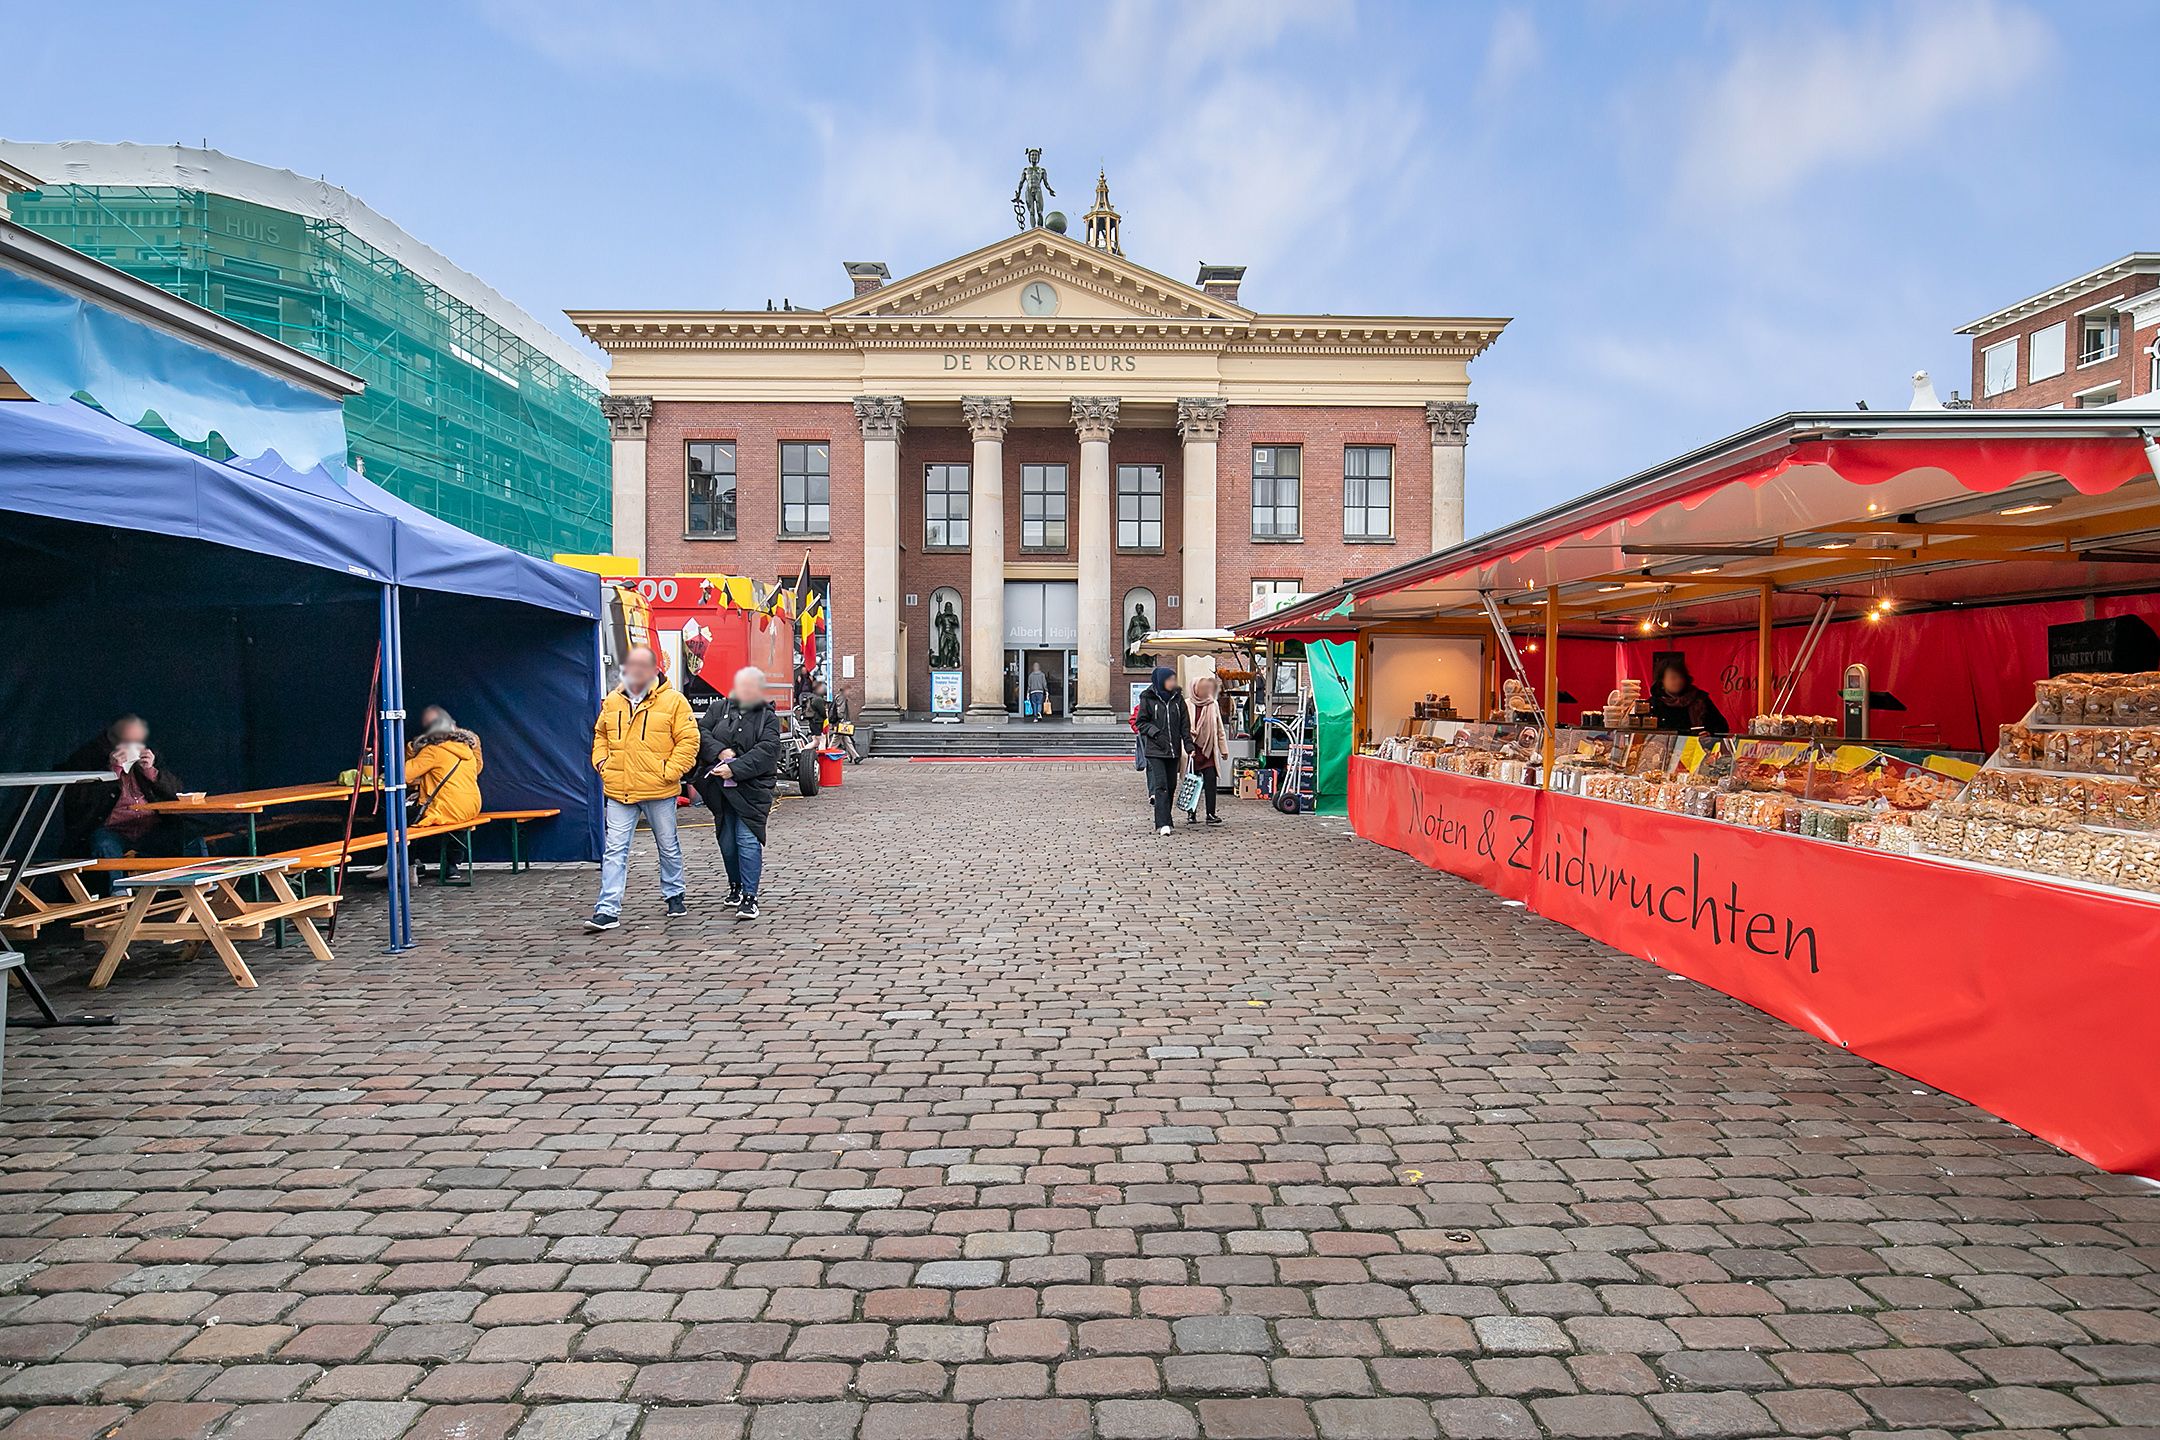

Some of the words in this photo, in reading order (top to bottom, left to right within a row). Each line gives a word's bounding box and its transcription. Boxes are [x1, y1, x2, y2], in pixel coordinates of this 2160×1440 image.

[225, 215, 280, 244] HUIS
[943, 354, 972, 371] DE
[986, 354, 1136, 372] KORENBEURS
[1050, 626, 1077, 640] Heijn
[2097, 649, 2113, 664] MIX
[1409, 787, 1467, 850] Noten
[1477, 809, 1496, 862] &
[1508, 814, 1820, 974] Zuidvruchten
